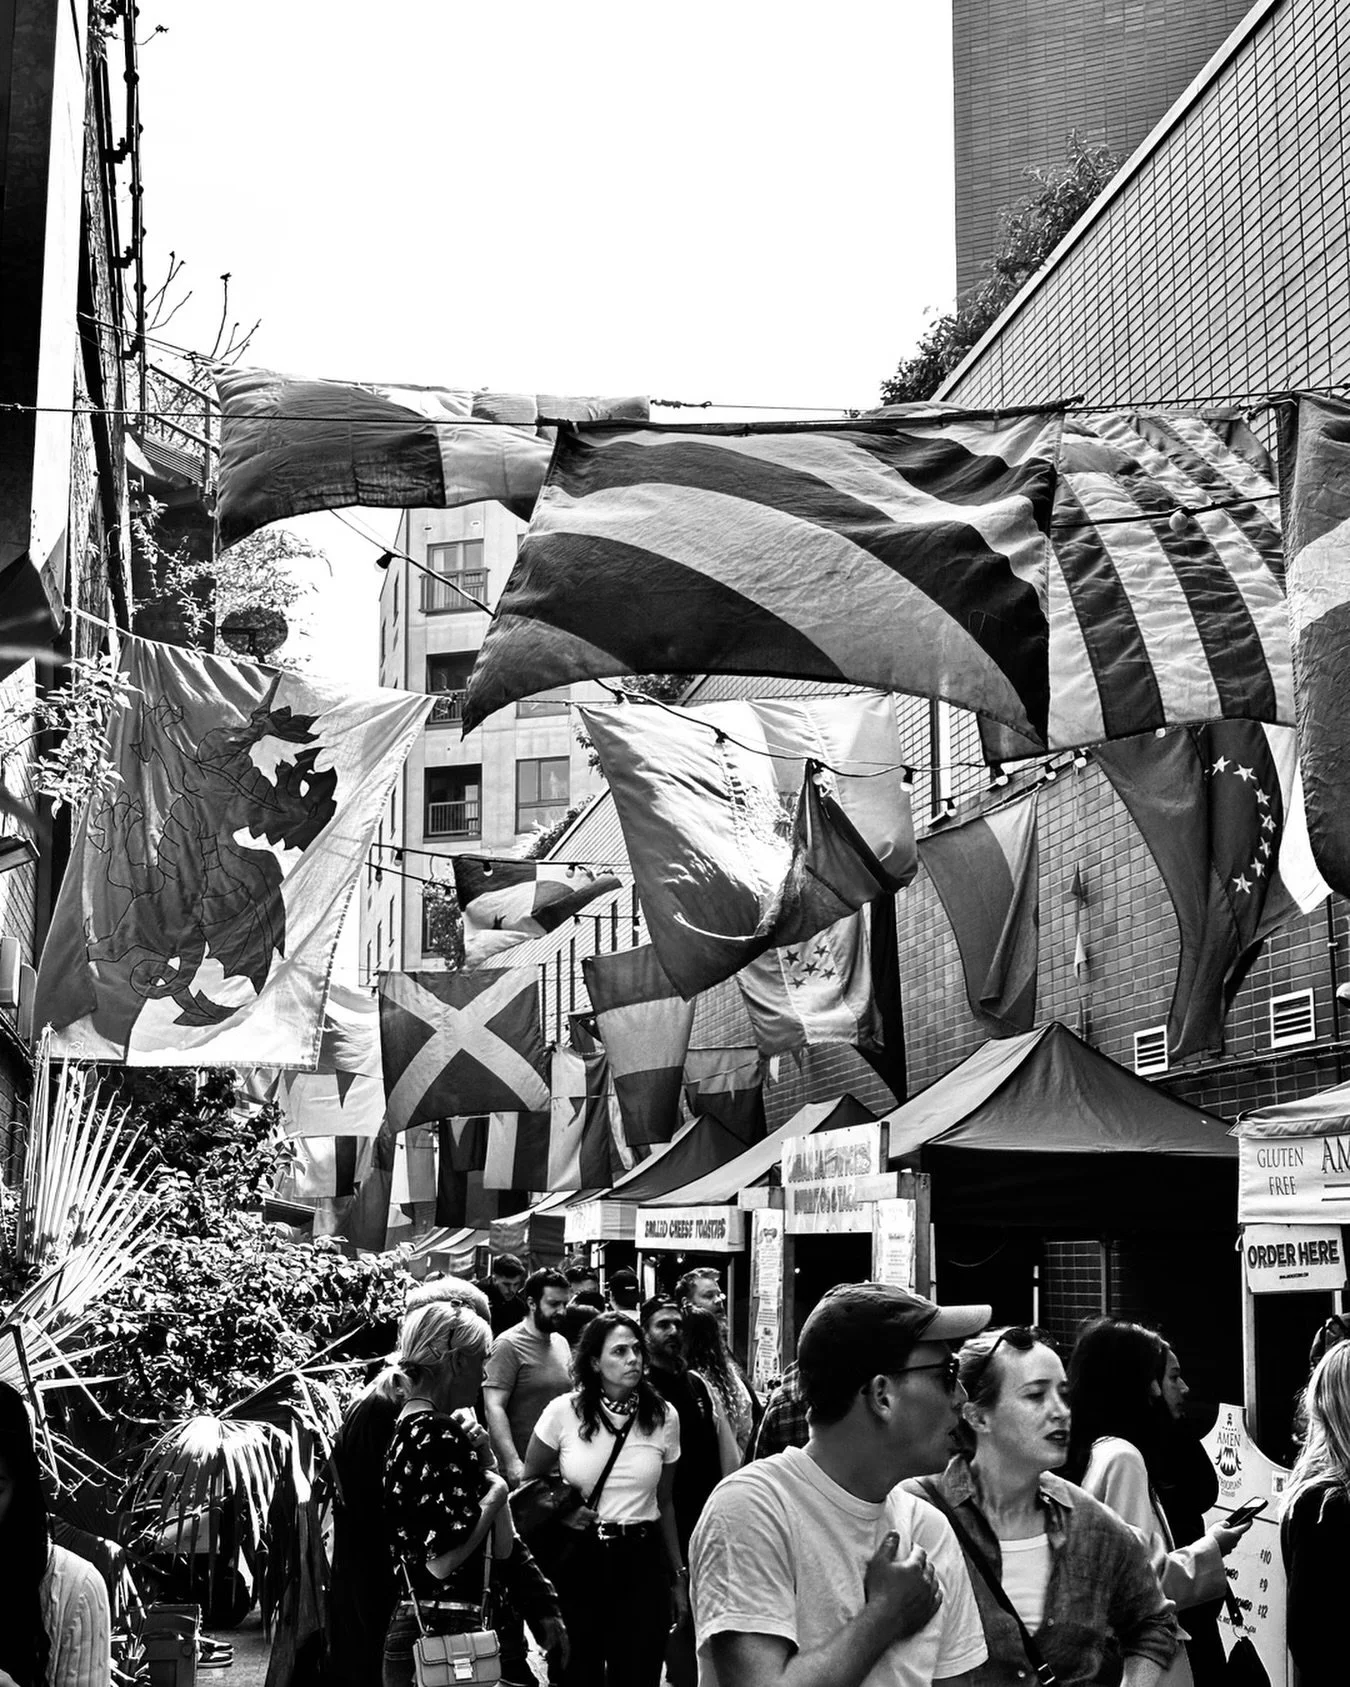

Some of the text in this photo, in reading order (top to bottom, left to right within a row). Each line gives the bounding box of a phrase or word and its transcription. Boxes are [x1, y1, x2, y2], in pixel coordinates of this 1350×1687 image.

[1257, 1147, 1304, 1168] GLUTEN
[1269, 1176, 1297, 1195] FREE
[669, 1219, 693, 1239] CHEESE
[1248, 1239, 1340, 1269] ORDER HERE
[1216, 1431, 1241, 1447] AMEN
